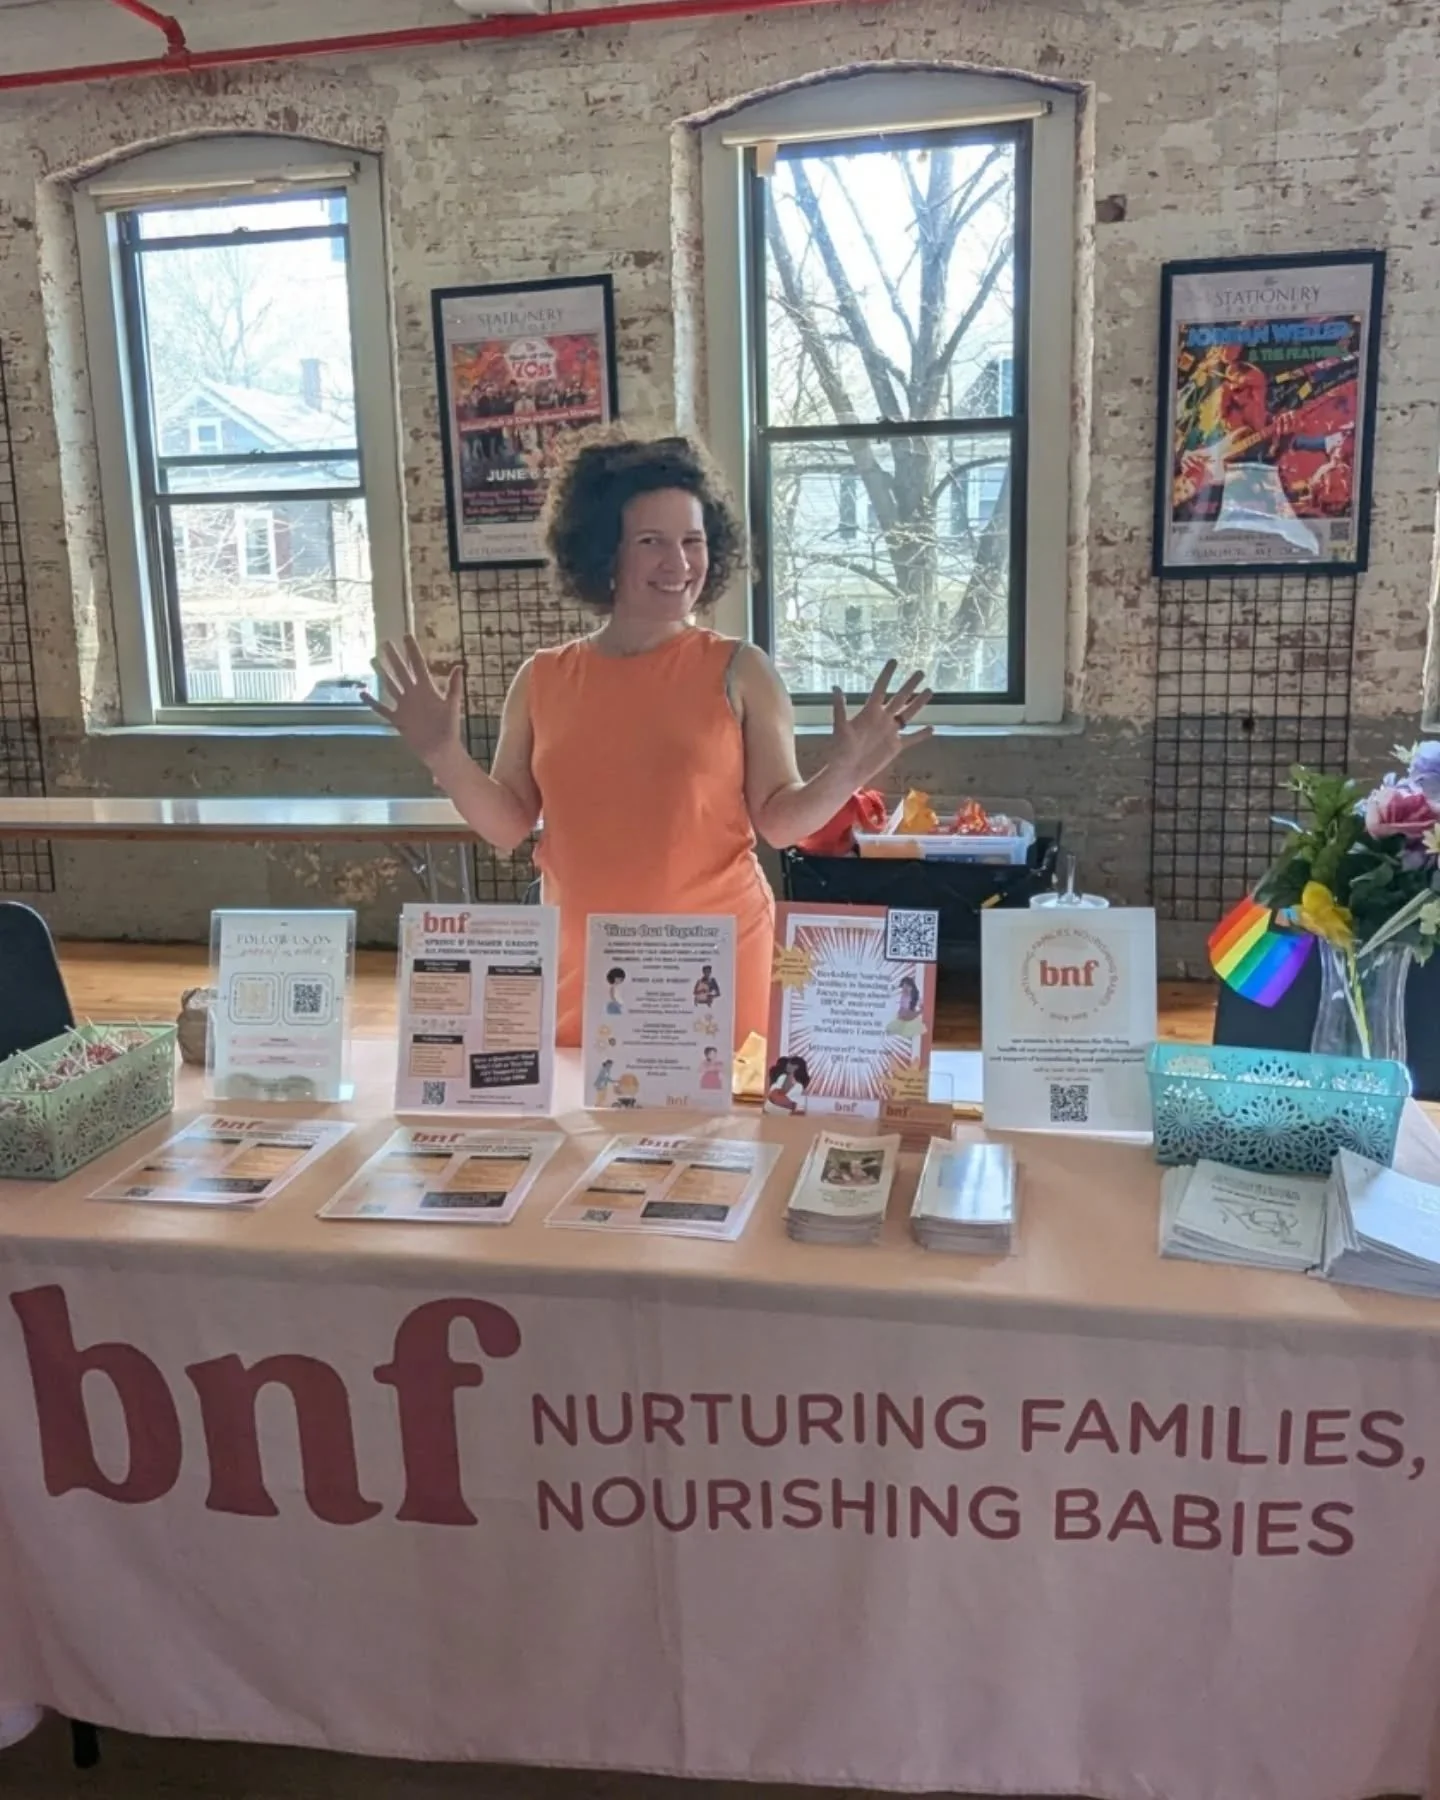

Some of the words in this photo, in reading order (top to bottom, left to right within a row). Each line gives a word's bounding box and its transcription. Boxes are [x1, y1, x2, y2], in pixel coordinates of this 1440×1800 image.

[1215, 285, 1321, 307] STATIONERY
[477, 307, 562, 326] STATIONERY
[486, 468, 526, 482] JUNE
[423, 911, 471, 933] bnf
[1040, 959, 1099, 987] bnf
[834, 1101, 858, 1112] bnf
[211, 1117, 263, 1130] bnf
[411, 1131, 465, 1143] bnf
[638, 1137, 687, 1149] bnf
[9, 1284, 521, 1525] bnf
[532, 1392, 986, 1450] NURTURING
[1021, 1399, 1426, 1480] FAMILIES,
[537, 1475, 1020, 1540] NOURISHING
[1055, 1489, 1354, 1556] BABIES
